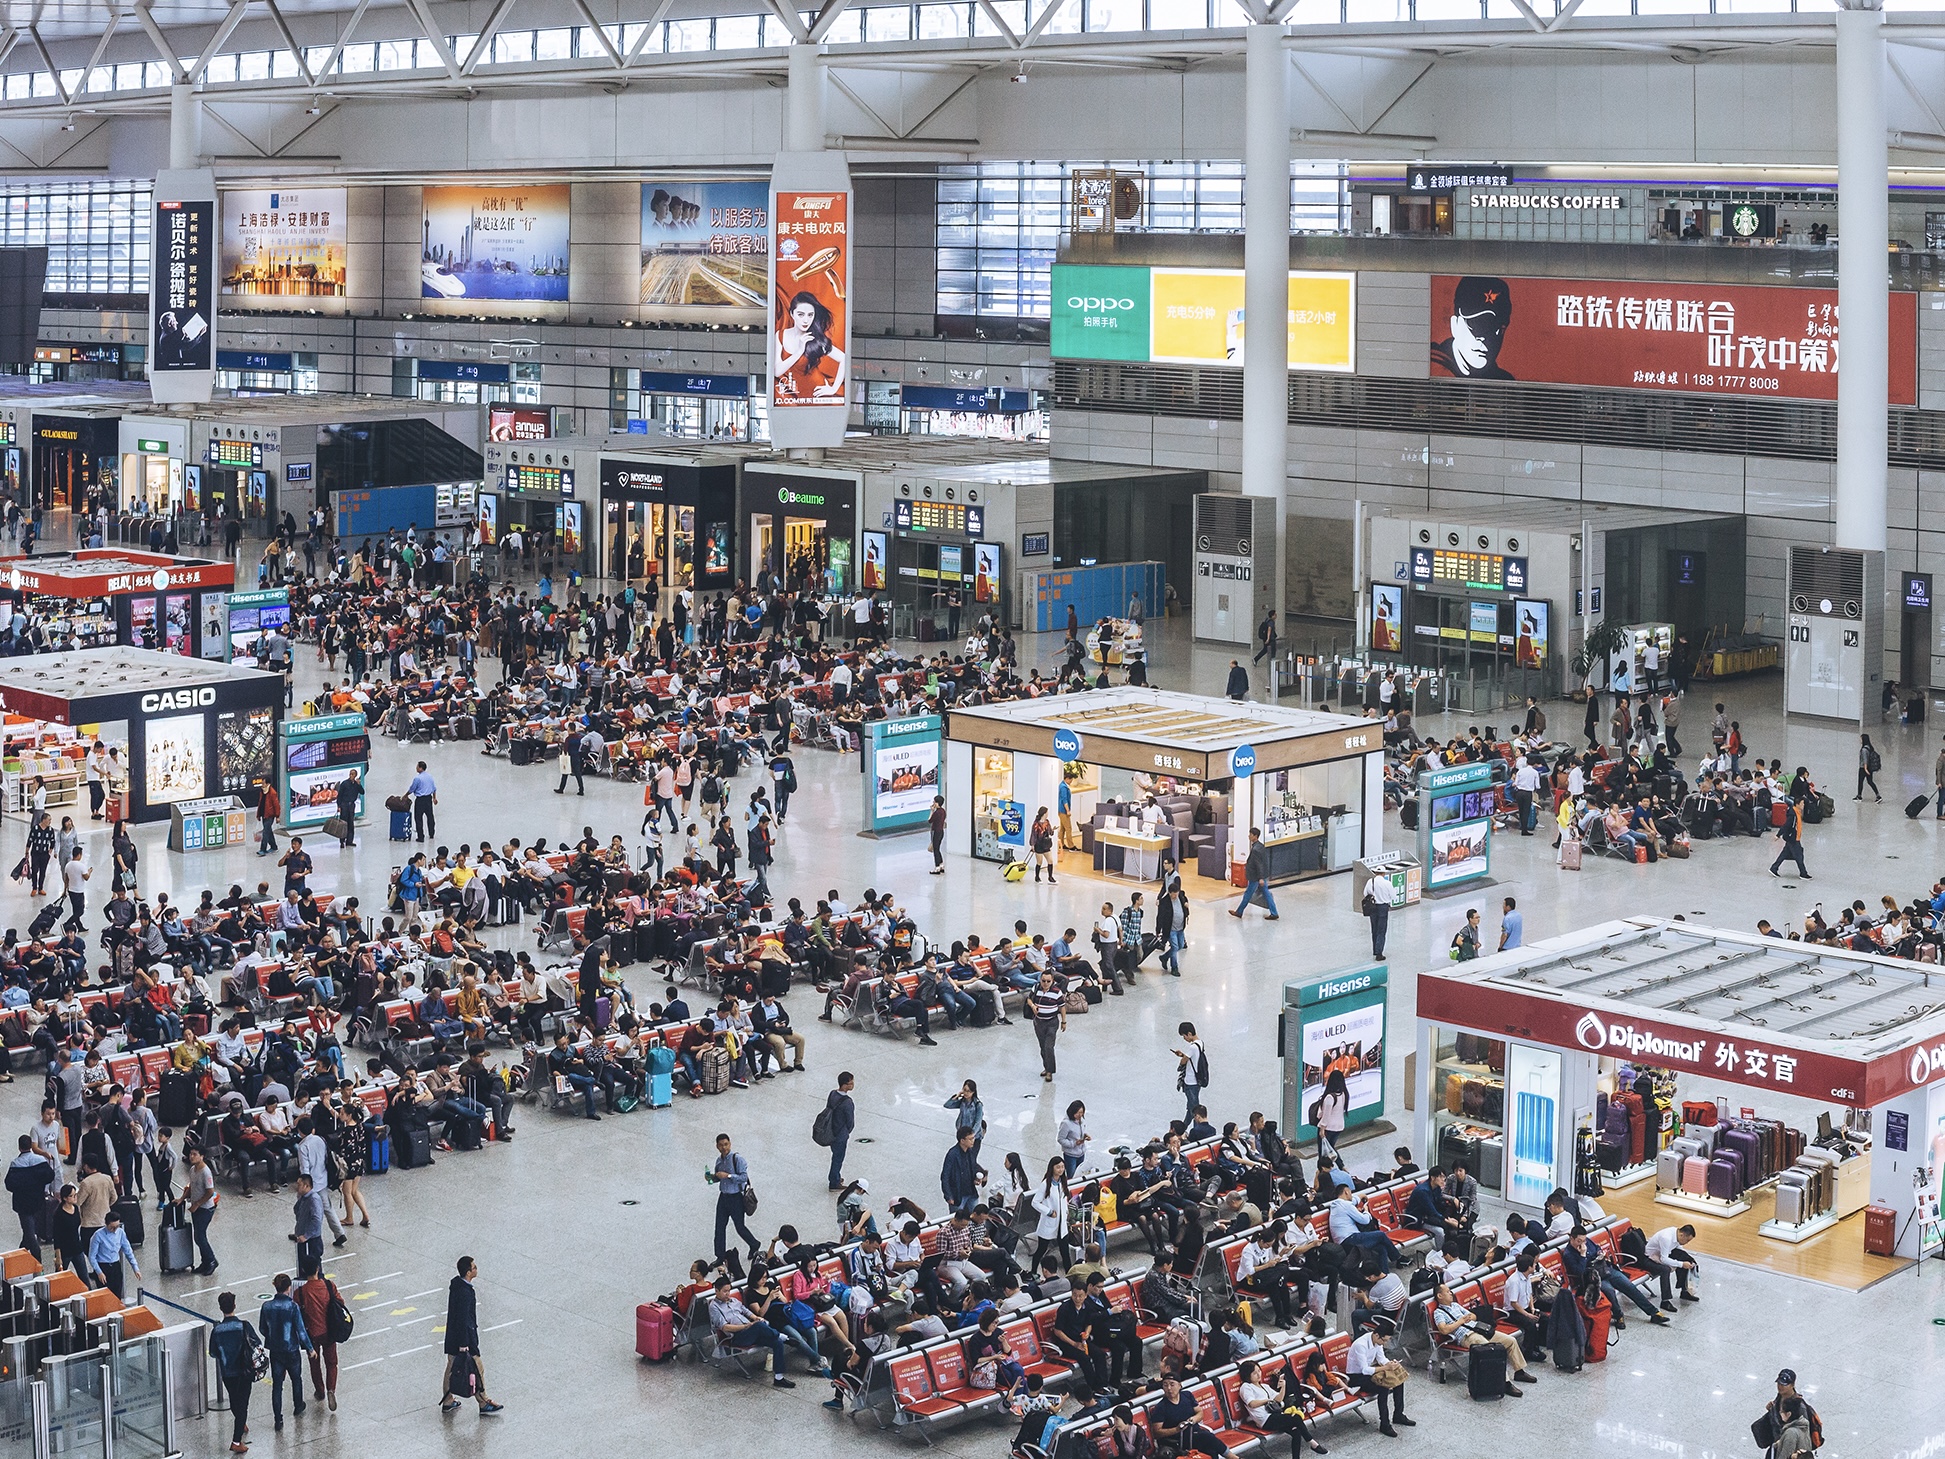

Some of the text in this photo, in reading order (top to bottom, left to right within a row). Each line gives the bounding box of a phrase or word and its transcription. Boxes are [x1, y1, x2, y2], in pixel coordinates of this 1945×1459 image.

[1083, 191, 1107, 205] Stores
[1471, 194, 1620, 209] STARBUCKS COFFEE
[710, 208, 767, 228] 以服务为
[189, 213, 198, 255] 更新技术
[777, 222, 846, 235] 康夫电吹风
[710, 233, 767, 254] 待旅客如
[1067, 297, 1135, 313] oppo
[1166, 306, 1216, 319] 充电5分钟
[1557, 294, 1735, 335] 路铁传媒联合
[1083, 316, 1118, 328] 拍照手机
[1693, 374, 1714, 386] 188
[1718, 375, 1746, 388] 1777
[1750, 377, 1779, 390] 8008
[515, 421, 545, 433] annwa
[630, 472, 663, 484] NORTHLAND
[789, 493, 825, 505] Beaume
[898, 503, 908, 515] 7A
[969, 510, 979, 522] 6A
[1416, 553, 1428, 566] 5A
[1509, 562, 1521, 575] 4A
[231, 593, 264, 603] Hisense
[141, 687, 216, 713] CASIO
[289, 720, 334, 734] Hisense
[887, 720, 928, 734] Hisense
[1055, 737, 1076, 751] breo
[1344, 735, 1367, 749] 倍轻松
[1154, 753, 1182, 770] 倍轻松
[1235, 756, 1254, 767] breo
[1433, 772, 1467, 787] Hisense
[1318, 975, 1371, 999] Hisense
[1325, 1023, 1346, 1038] ULED
[1609, 1024, 1798, 1084] Diplomat 外交官
[1831, 1087, 1848, 1098] cdf
